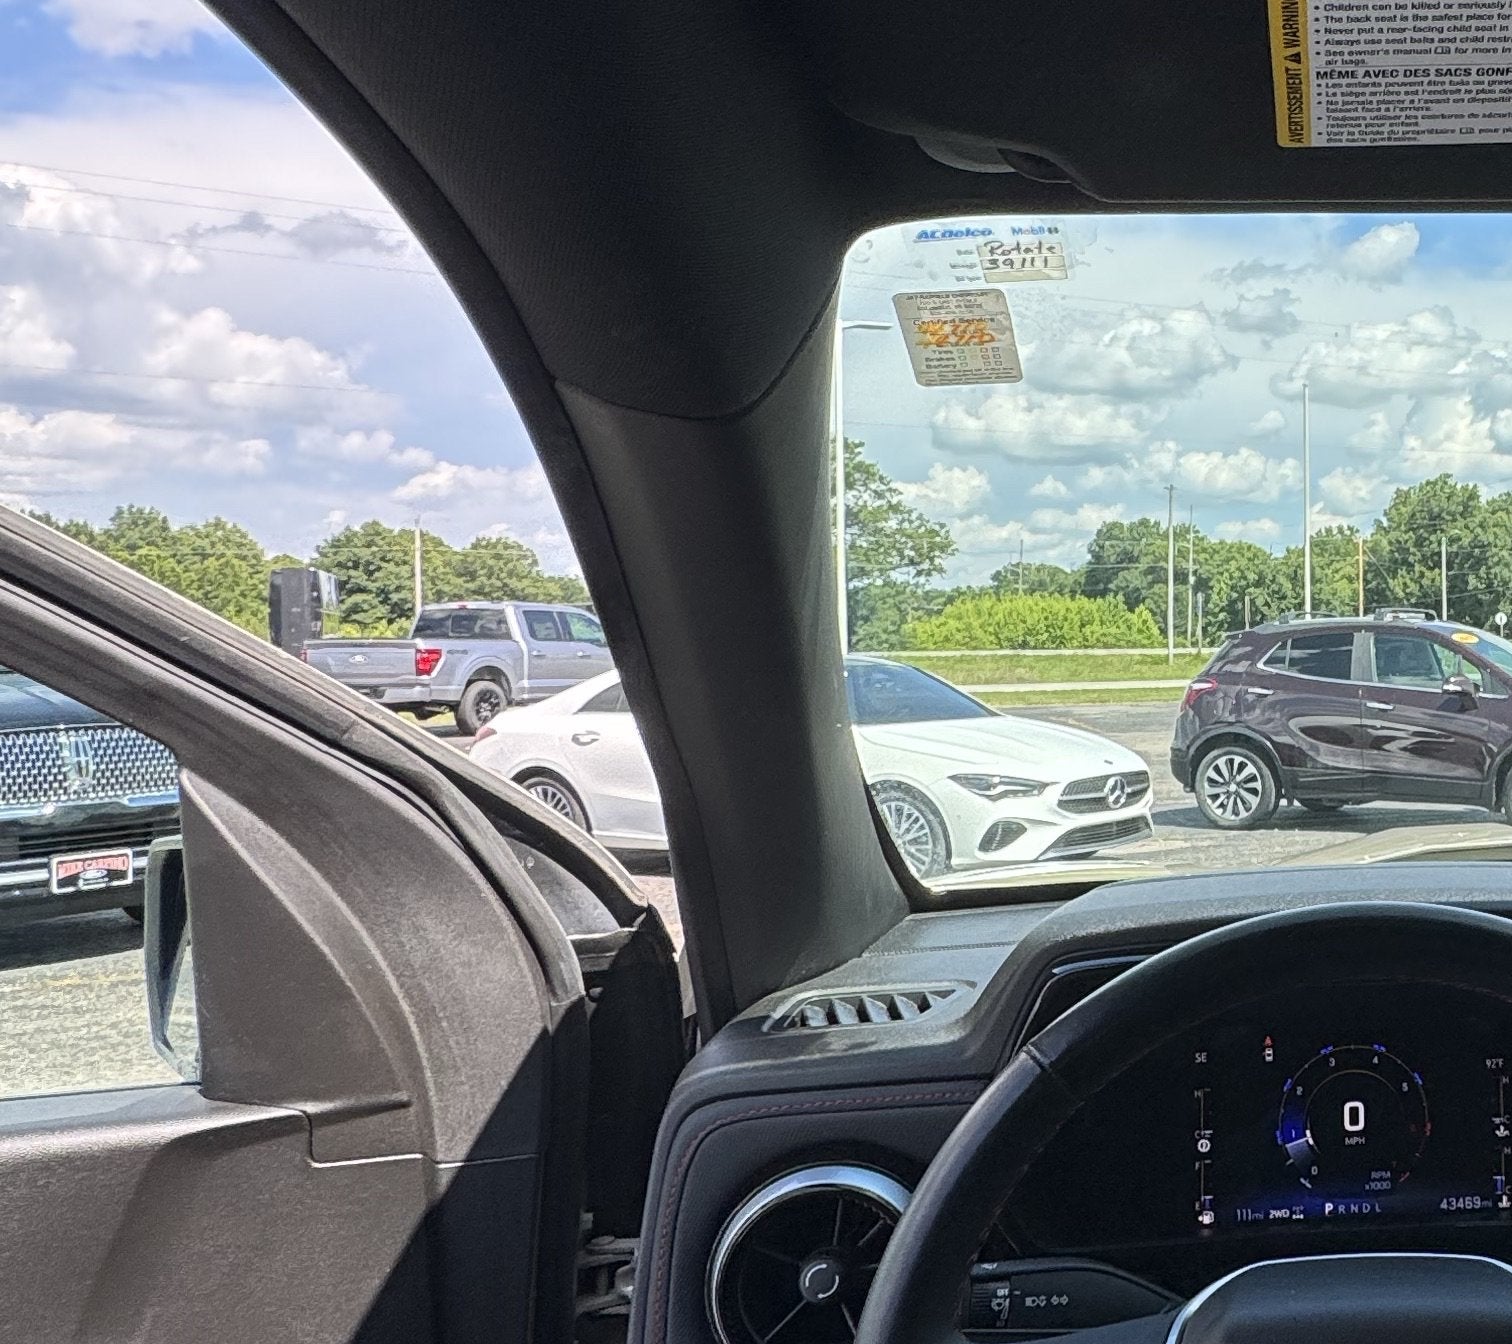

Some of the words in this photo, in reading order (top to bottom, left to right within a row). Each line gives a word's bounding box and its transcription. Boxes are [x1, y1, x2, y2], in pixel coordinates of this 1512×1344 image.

[1324, 3, 1369, 12] Children
[1395, 2, 1408, 10] be
[1411, 1, 1441, 10] killed
[1458, 1, 1506, 10] seriously
[1324, 15, 1343, 23] The
[1346, 15, 1372, 23] back
[1375, 14, 1398, 22] seat
[1431, 13, 1464, 21] safest
[1466, 13, 1494, 22] place
[1497, 12, 1511, 20] for
[1324, 27, 1355, 35] Never
[1357, 26, 1375, 35] put
[1387, 26, 1444, 34] rear-facing
[1446, 24, 1472, 32] child
[1474, 24, 1497, 32] seat
[1324, 38, 1361, 47] Always
[1385, 37, 1408, 45] seat
[1410, 36, 1435, 44] belts
[1437, 36, 1457, 44] and
[1324, 49, 1345, 57] See
[1347, 48, 1390, 56] owner's
[1393, 47, 1432, 55] manual
[1454, 46, 1469, 54] for
[1315, 69, 1359, 80] MÊME
[1361, 69, 1399, 79] AVEC
[1403, 68, 1431, 78] DES
[1434, 68, 1473, 77] SACS
[1284, 67, 1305, 144] AVERTISSEMENT
[1194, 1052, 1208, 1064] SE
[1328, 1057, 1336, 1067] 3
[1371, 1055, 1379, 1064] 4
[1296, 1086, 1304, 1096] 2
[1401, 1082, 1409, 1092] 5
[1343, 1101, 1365, 1132] 0
[1344, 1136, 1366, 1146] MPH
[1311, 1166, 1319, 1175] 0
[1371, 1170, 1391, 1180] RPM
[1268, 1208, 1290, 1219] 2WD
[1324, 1202, 1334, 1216] P
[1338, 1204, 1346, 1214] R
[1350, 1203, 1359, 1213] N
[1362, 1203, 1371, 1213] D
[1375, 1203, 1382, 1213] L
